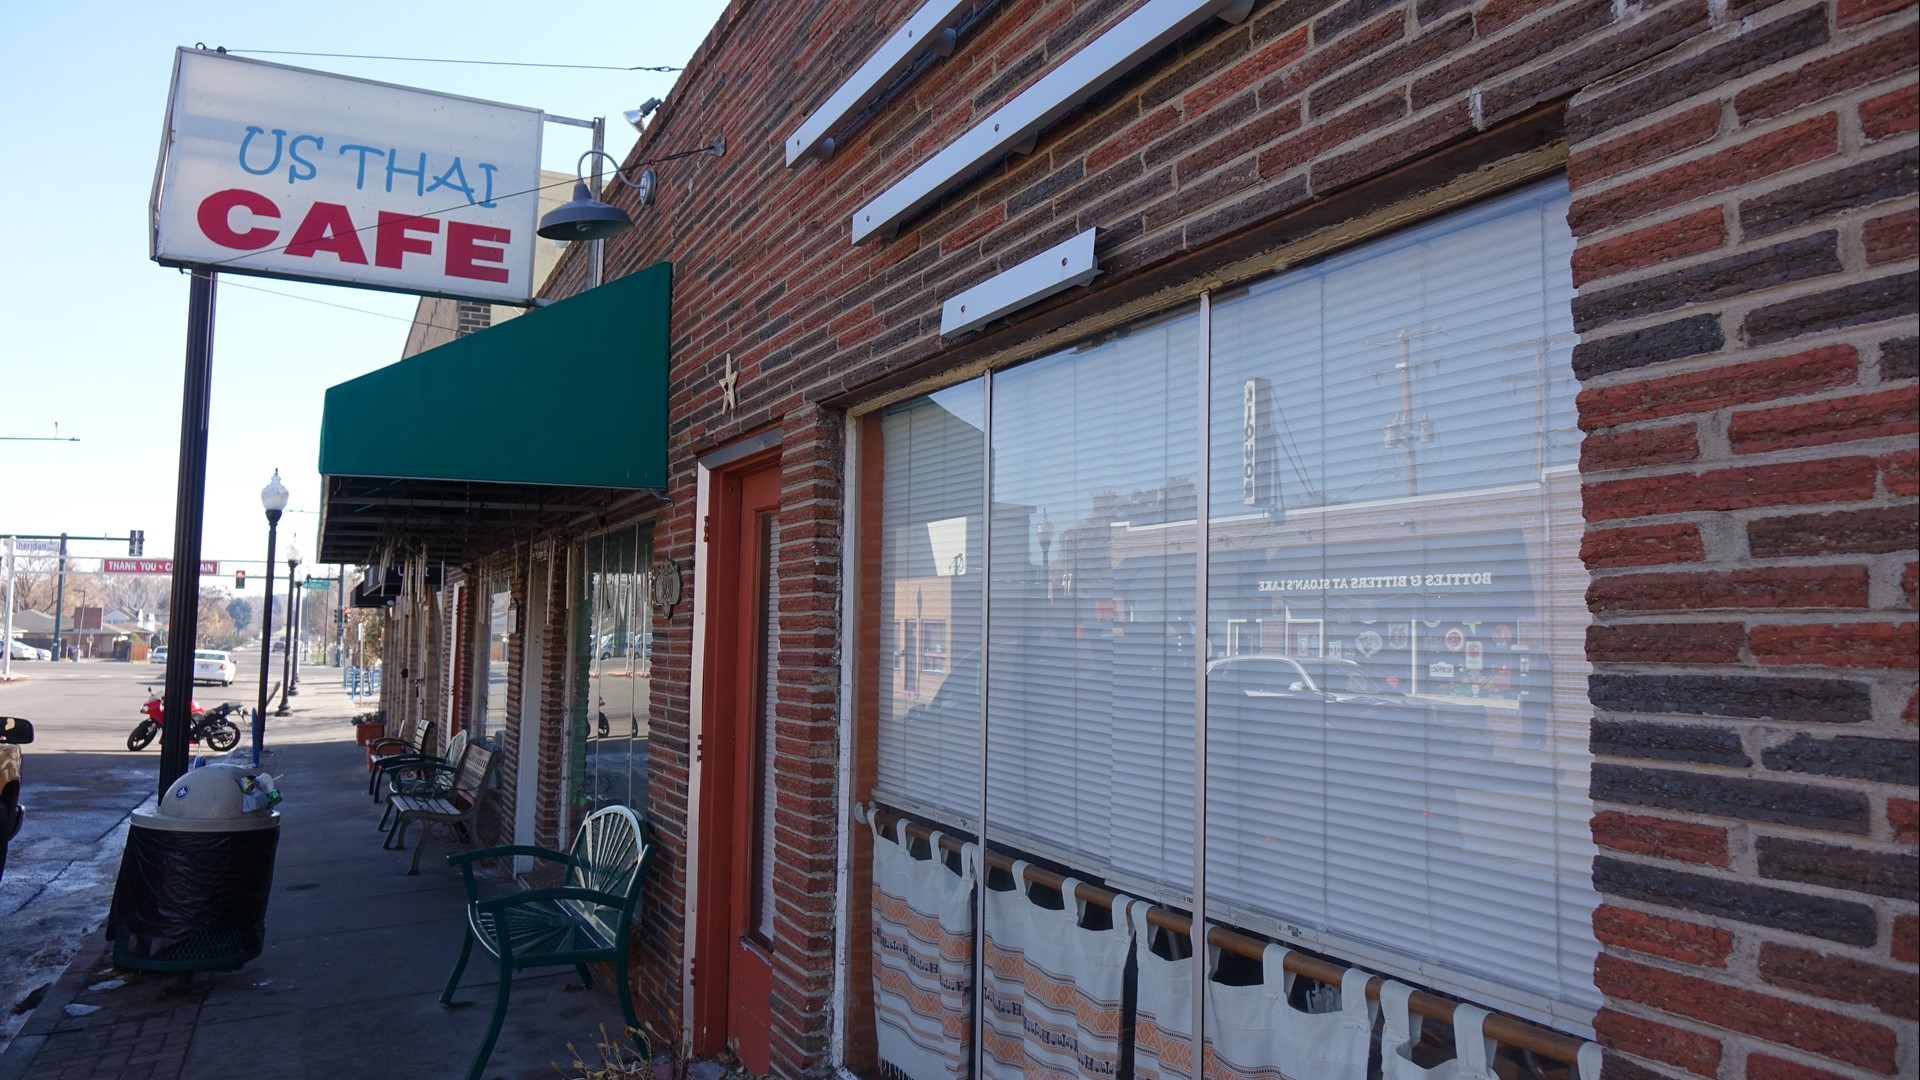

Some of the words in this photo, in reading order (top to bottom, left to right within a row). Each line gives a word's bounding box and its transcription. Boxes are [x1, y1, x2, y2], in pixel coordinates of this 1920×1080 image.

[239, 126, 323, 184] US
[339, 144, 498, 208] THAI
[197, 188, 511, 284] CAFE
[108, 561, 136, 571] THANK
[140, 562, 157, 572] YOU
